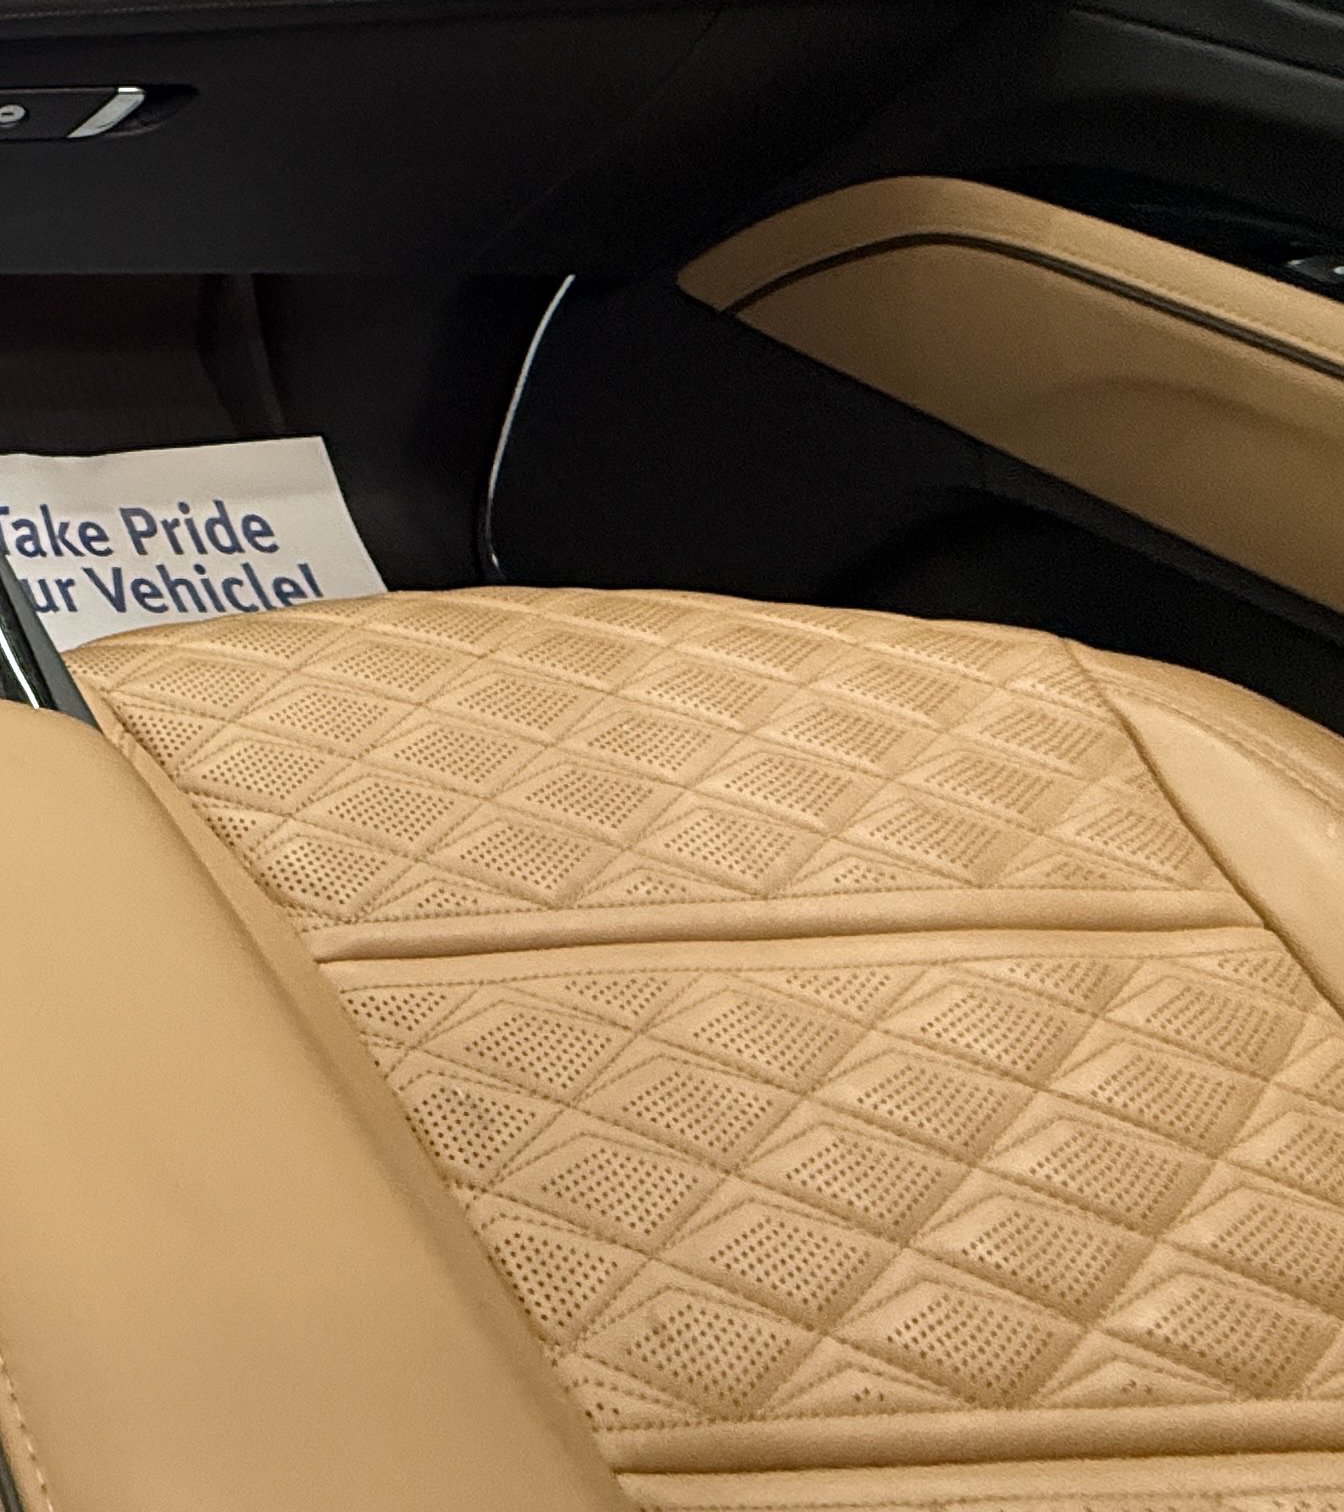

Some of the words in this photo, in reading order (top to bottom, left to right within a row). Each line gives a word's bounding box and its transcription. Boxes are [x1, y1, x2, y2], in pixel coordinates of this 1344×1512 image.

[119, 499, 280, 554] Pride
[18, 577, 79, 614] ur
[80, 561, 324, 614] Vehicle!
